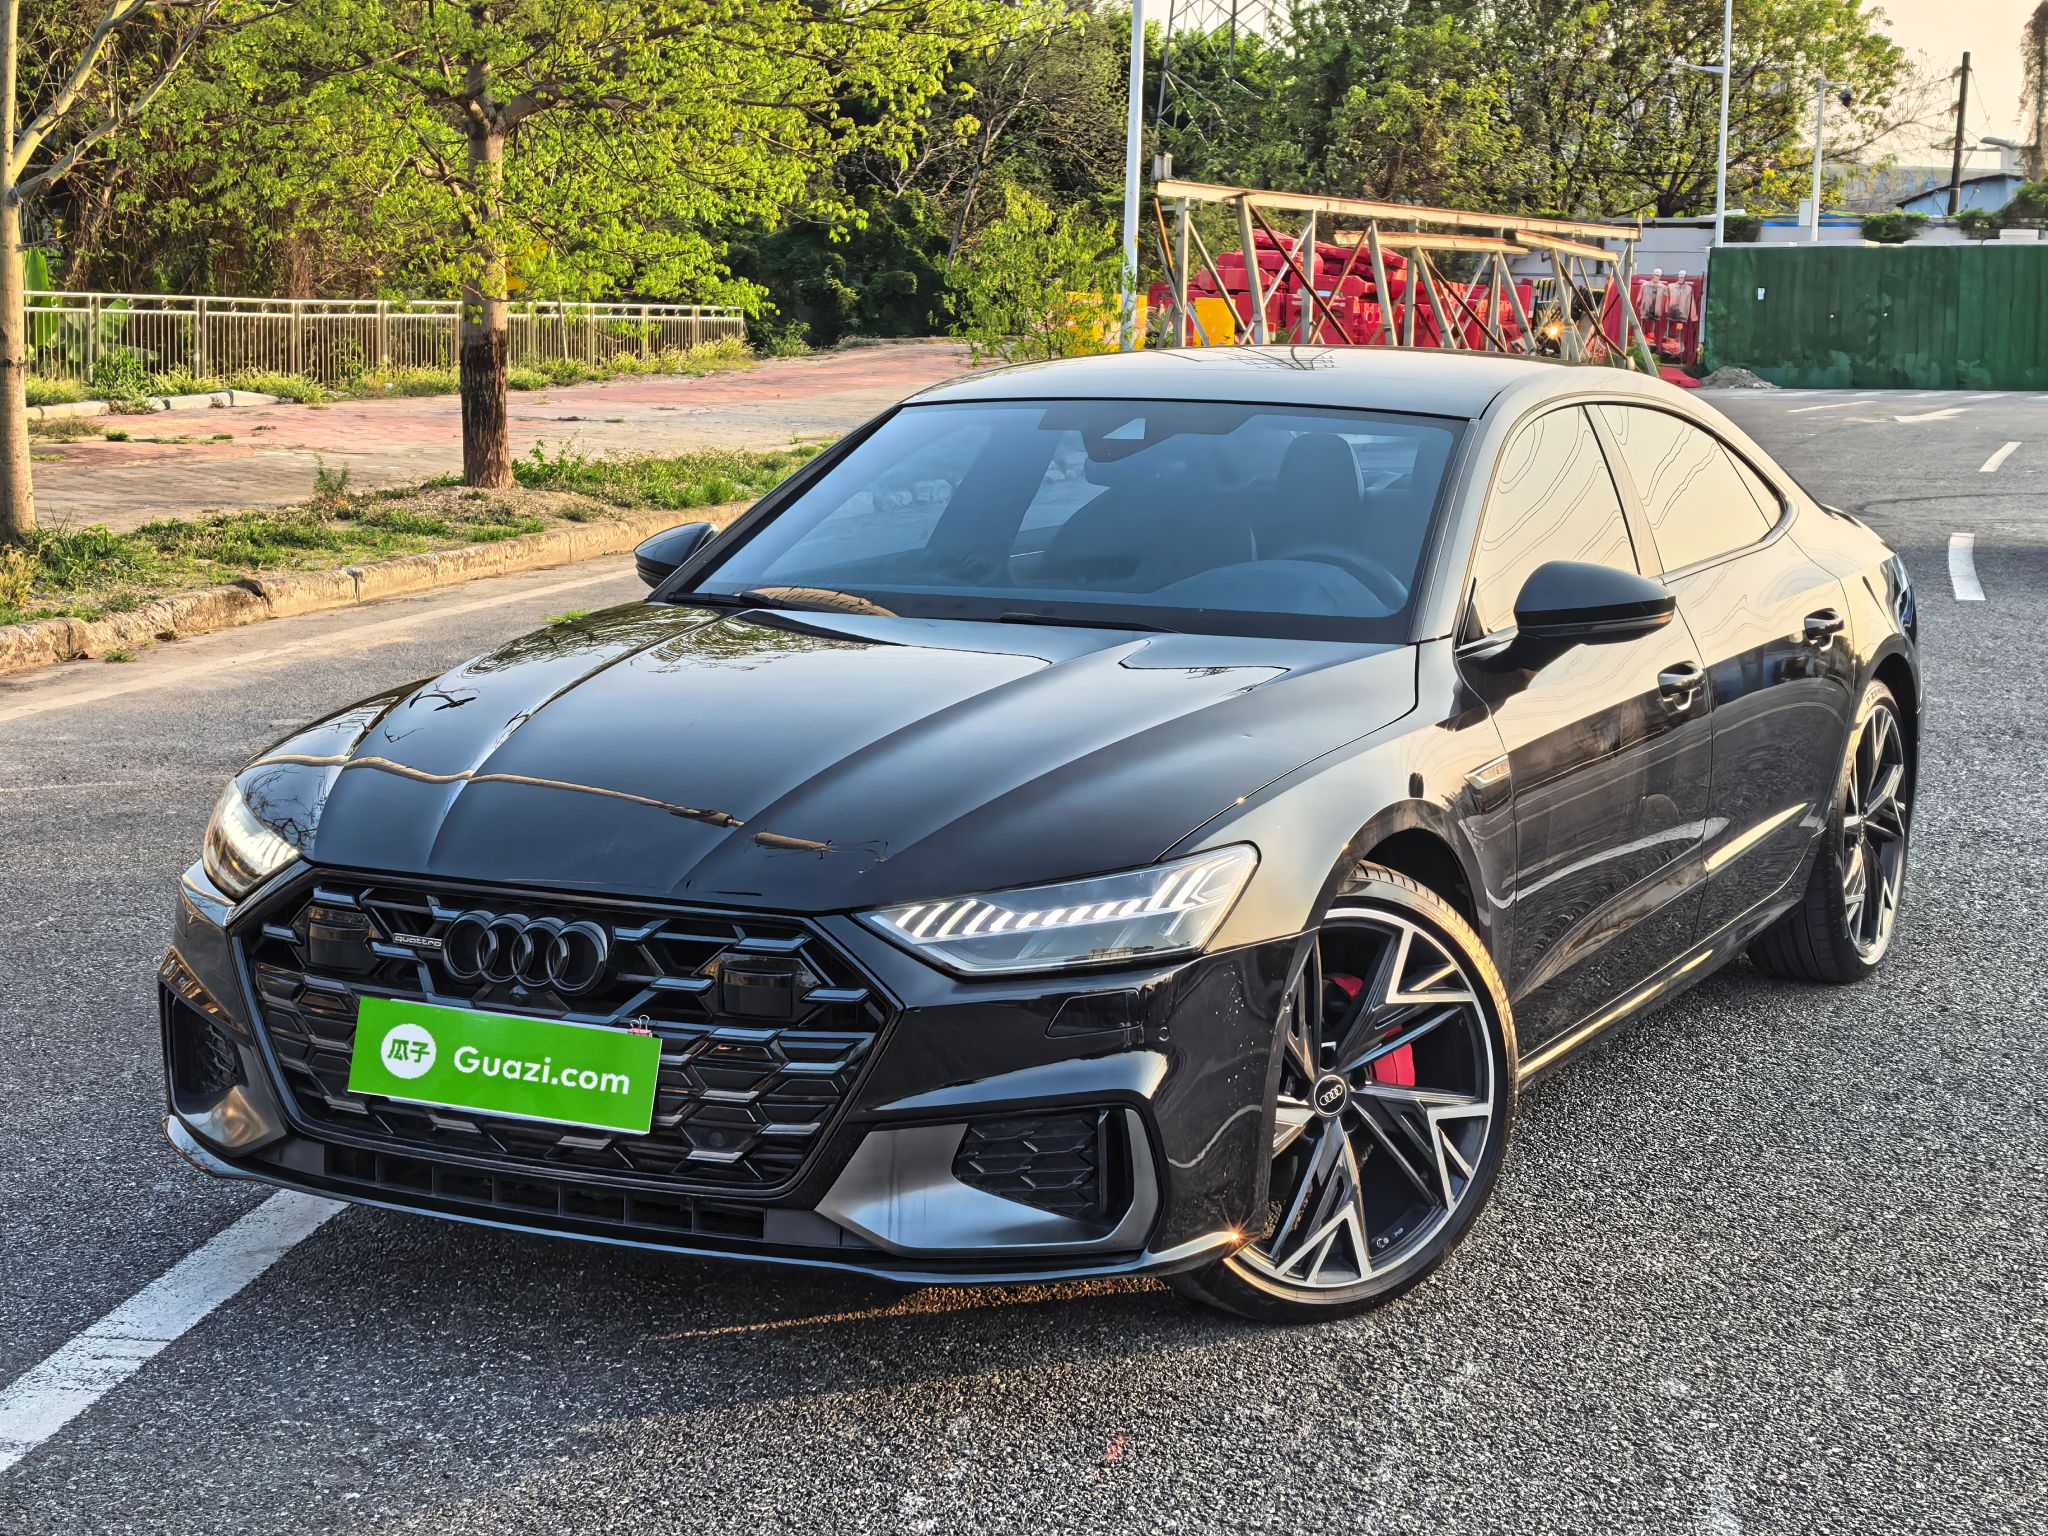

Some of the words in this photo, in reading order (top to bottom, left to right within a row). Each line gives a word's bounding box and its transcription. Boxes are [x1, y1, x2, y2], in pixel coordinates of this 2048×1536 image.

[394, 935, 442, 947] quattro
[387, 1038, 431, 1064] 瓜子
[453, 1045, 630, 1095] Guazi.com
